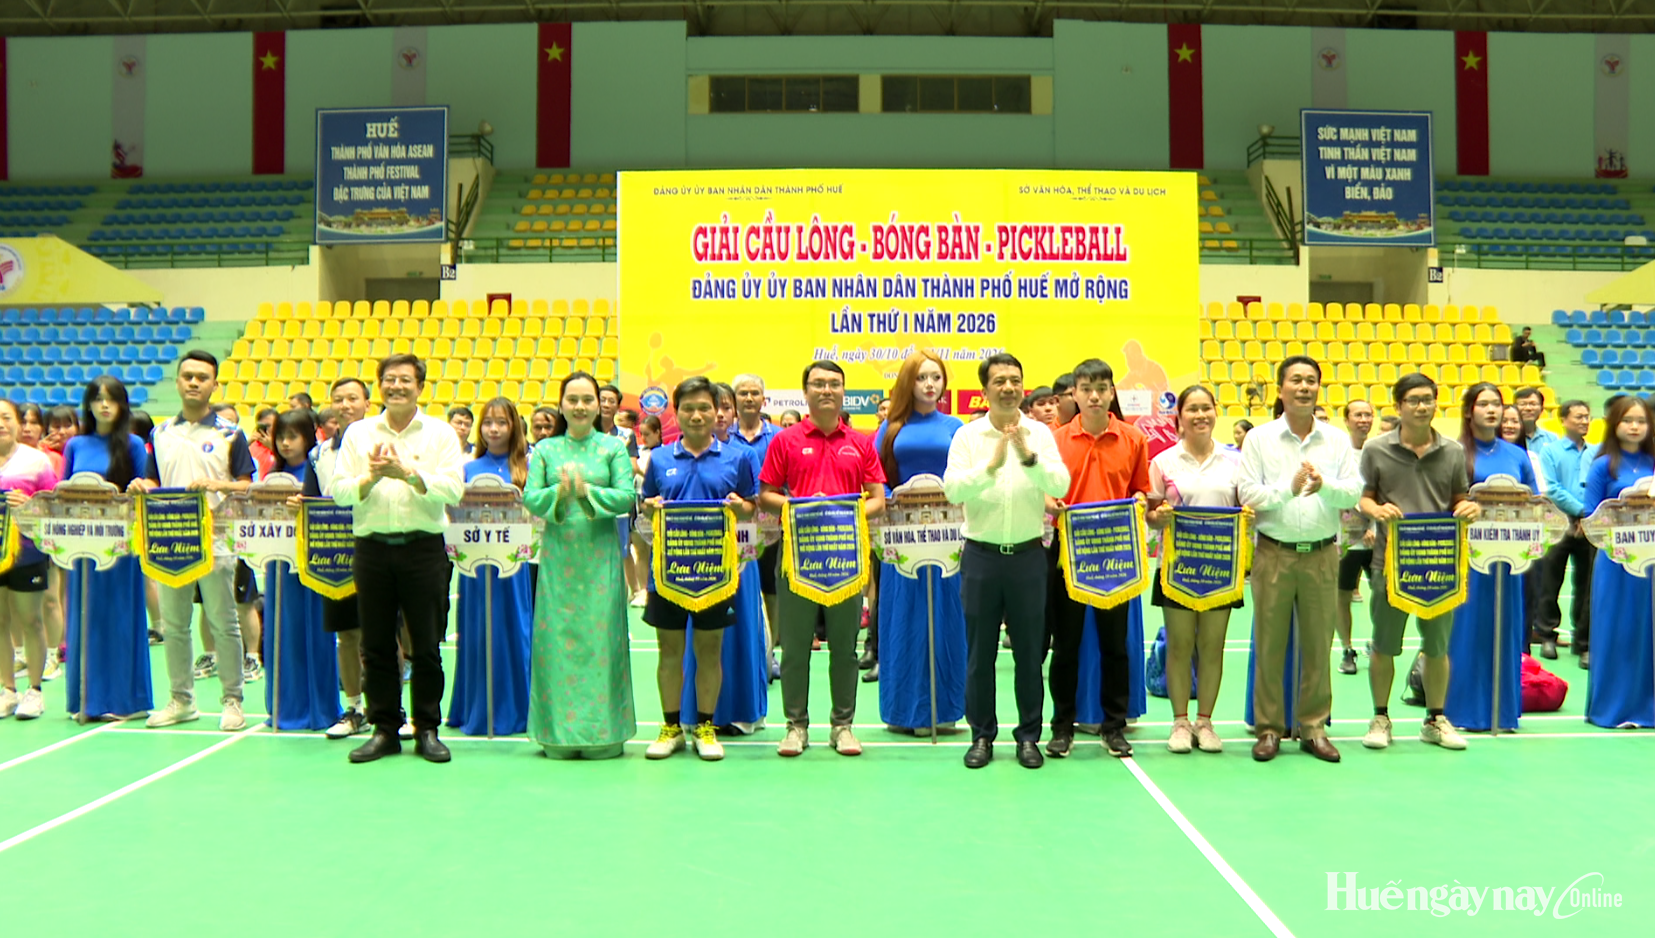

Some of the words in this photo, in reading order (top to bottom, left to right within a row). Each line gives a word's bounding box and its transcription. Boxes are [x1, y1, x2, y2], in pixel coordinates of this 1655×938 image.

[365, 116, 399, 138] HUẾ
[1317, 125, 1337, 141] SỨC
[1339, 128, 1369, 143] MẠNH
[1371, 126, 1392, 144] VIỆT
[1394, 129, 1417, 142] NAM
[331, 144, 356, 160] THÀNH
[356, 140, 373, 159] PHỐ
[373, 143, 390, 159] VĂN
[390, 142, 406, 159] HÓA
[407, 144, 434, 158] ASEAN
[1318, 146, 1341, 160] TINH
[1371, 145, 1392, 163] VIỆT
[1394, 148, 1417, 161] NAM
[343, 163, 368, 180] THÀNH
[369, 161, 385, 179] PHỐ
[386, 165, 420, 179] FESTIVAL
[1325, 164, 1336, 179] VÌ
[1337, 164, 1358, 182] MỘT
[1360, 164, 1383, 180] MÀU
[1384, 168, 1412, 181] XANH
[393, 183, 410, 202] VIỆT
[411, 185, 430, 199] NAM
[653, 185, 679, 195] ĐẢNG
[708, 187, 725, 195] BAN
[727, 184, 752, 194] NHÂN
[754, 184, 772, 194] DÂN
[775, 184, 803, 194] THÀNH
[806, 183, 824, 194] PHỐ
[827, 183, 844, 193] HUẾ
[1019, 184, 1031, 194] SỞ
[1033, 184, 1051, 194] VĂN
[1077, 183, 1092, 194] THỂ
[1094, 187, 1117, 195] THAO
[1119, 185, 1131, 195] VÀ
[1133, 188, 1145, 196] DU
[1147, 188, 1166, 197] LỊCH
[693, 213, 740, 262] GIẢI
[745, 211, 790, 261] CẦU
[796, 215, 855, 261] LÔNG
[872, 213, 931, 260] BÓNG
[937, 213, 980, 260] BÀN
[997, 224, 1127, 261] PICKLEBALL
[442, 265, 456, 279] B2
[1429, 268, 1443, 281] B2
[692, 272, 736, 299] ĐẢNG
[742, 272, 762, 299] ỦY
[768, 272, 787, 298] ỦY
[793, 278, 826, 298] BAN
[832, 274, 877, 298] NHÂN
[883, 274, 916, 298] DÂN
[922, 273, 974, 298] THÀNH
[980, 271, 1014, 298] PHỐ
[1018, 271, 1049, 298] HUẾ
[1054, 272, 1080, 298] MỞ
[1085, 274, 1129, 303] RỘNG
[831, 305, 862, 333] LẦN
[867, 307, 899, 332] THỨ
[903, 313, 908, 332] I
[914, 308, 951, 333] NĂM
[957, 313, 996, 333] 2026
[814, 345, 838, 361] Huế,
[842, 347, 867, 362] ngày
[870, 348, 898, 360] 30/10
[953, 349, 976, 359] năm
[842, 395, 869, 407] BIDV
[239, 521, 255, 537] SỞ
[259, 522, 281, 537] XÂY
[463, 525, 480, 543] SỞ
[484, 530, 491, 542] Y
[495, 526, 510, 543] TẾ
[1470, 527, 1482, 540] BAN
[1500, 528, 1511, 541] TRA
[1512, 526, 1531, 541] THÀNH
[1615, 531, 1635, 544] BAN
[667, 561, 690, 574] Lưu
[800, 558, 822, 571] Lưu
[825, 556, 856, 571] Niệm
[1077, 561, 1099, 573] Lưu
[1102, 558, 1134, 572] Niệm
[1174, 562, 1196, 575] Lưu
[1200, 564, 1230, 579] Niệm
[1400, 570, 1422, 583] Lưu
[1425, 570, 1455, 584] Niệm
